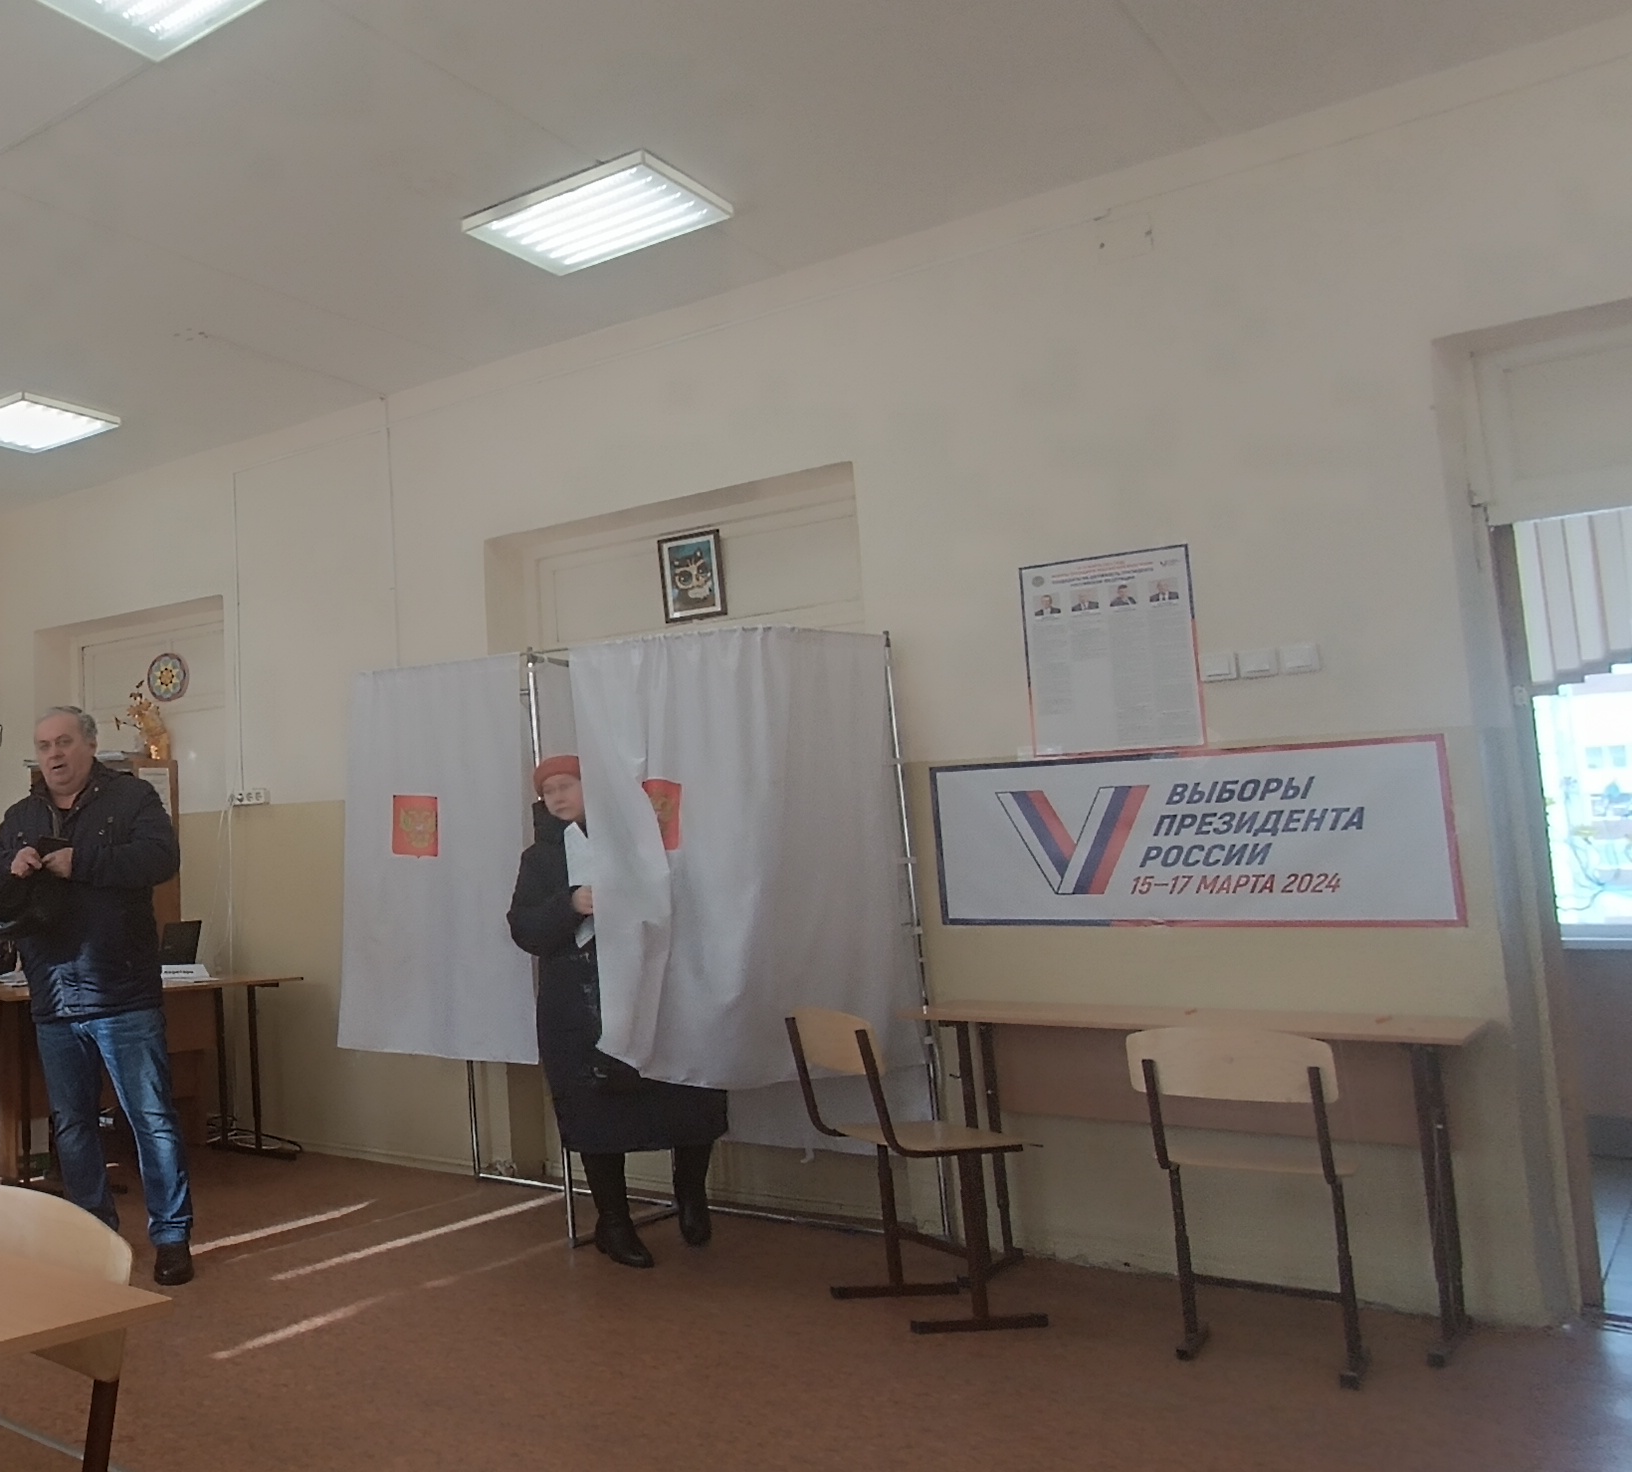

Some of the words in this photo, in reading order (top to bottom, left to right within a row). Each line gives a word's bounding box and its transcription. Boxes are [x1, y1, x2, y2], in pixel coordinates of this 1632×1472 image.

[1165, 776, 1315, 806] ВЫБОРЫ
[1152, 806, 1365, 837] ПРЕЗИДЕНТА
[1139, 842, 1273, 868] РОССИИ
[1195, 873, 1276, 894] МАРТА
[1281, 872, 1342, 894] 2024
